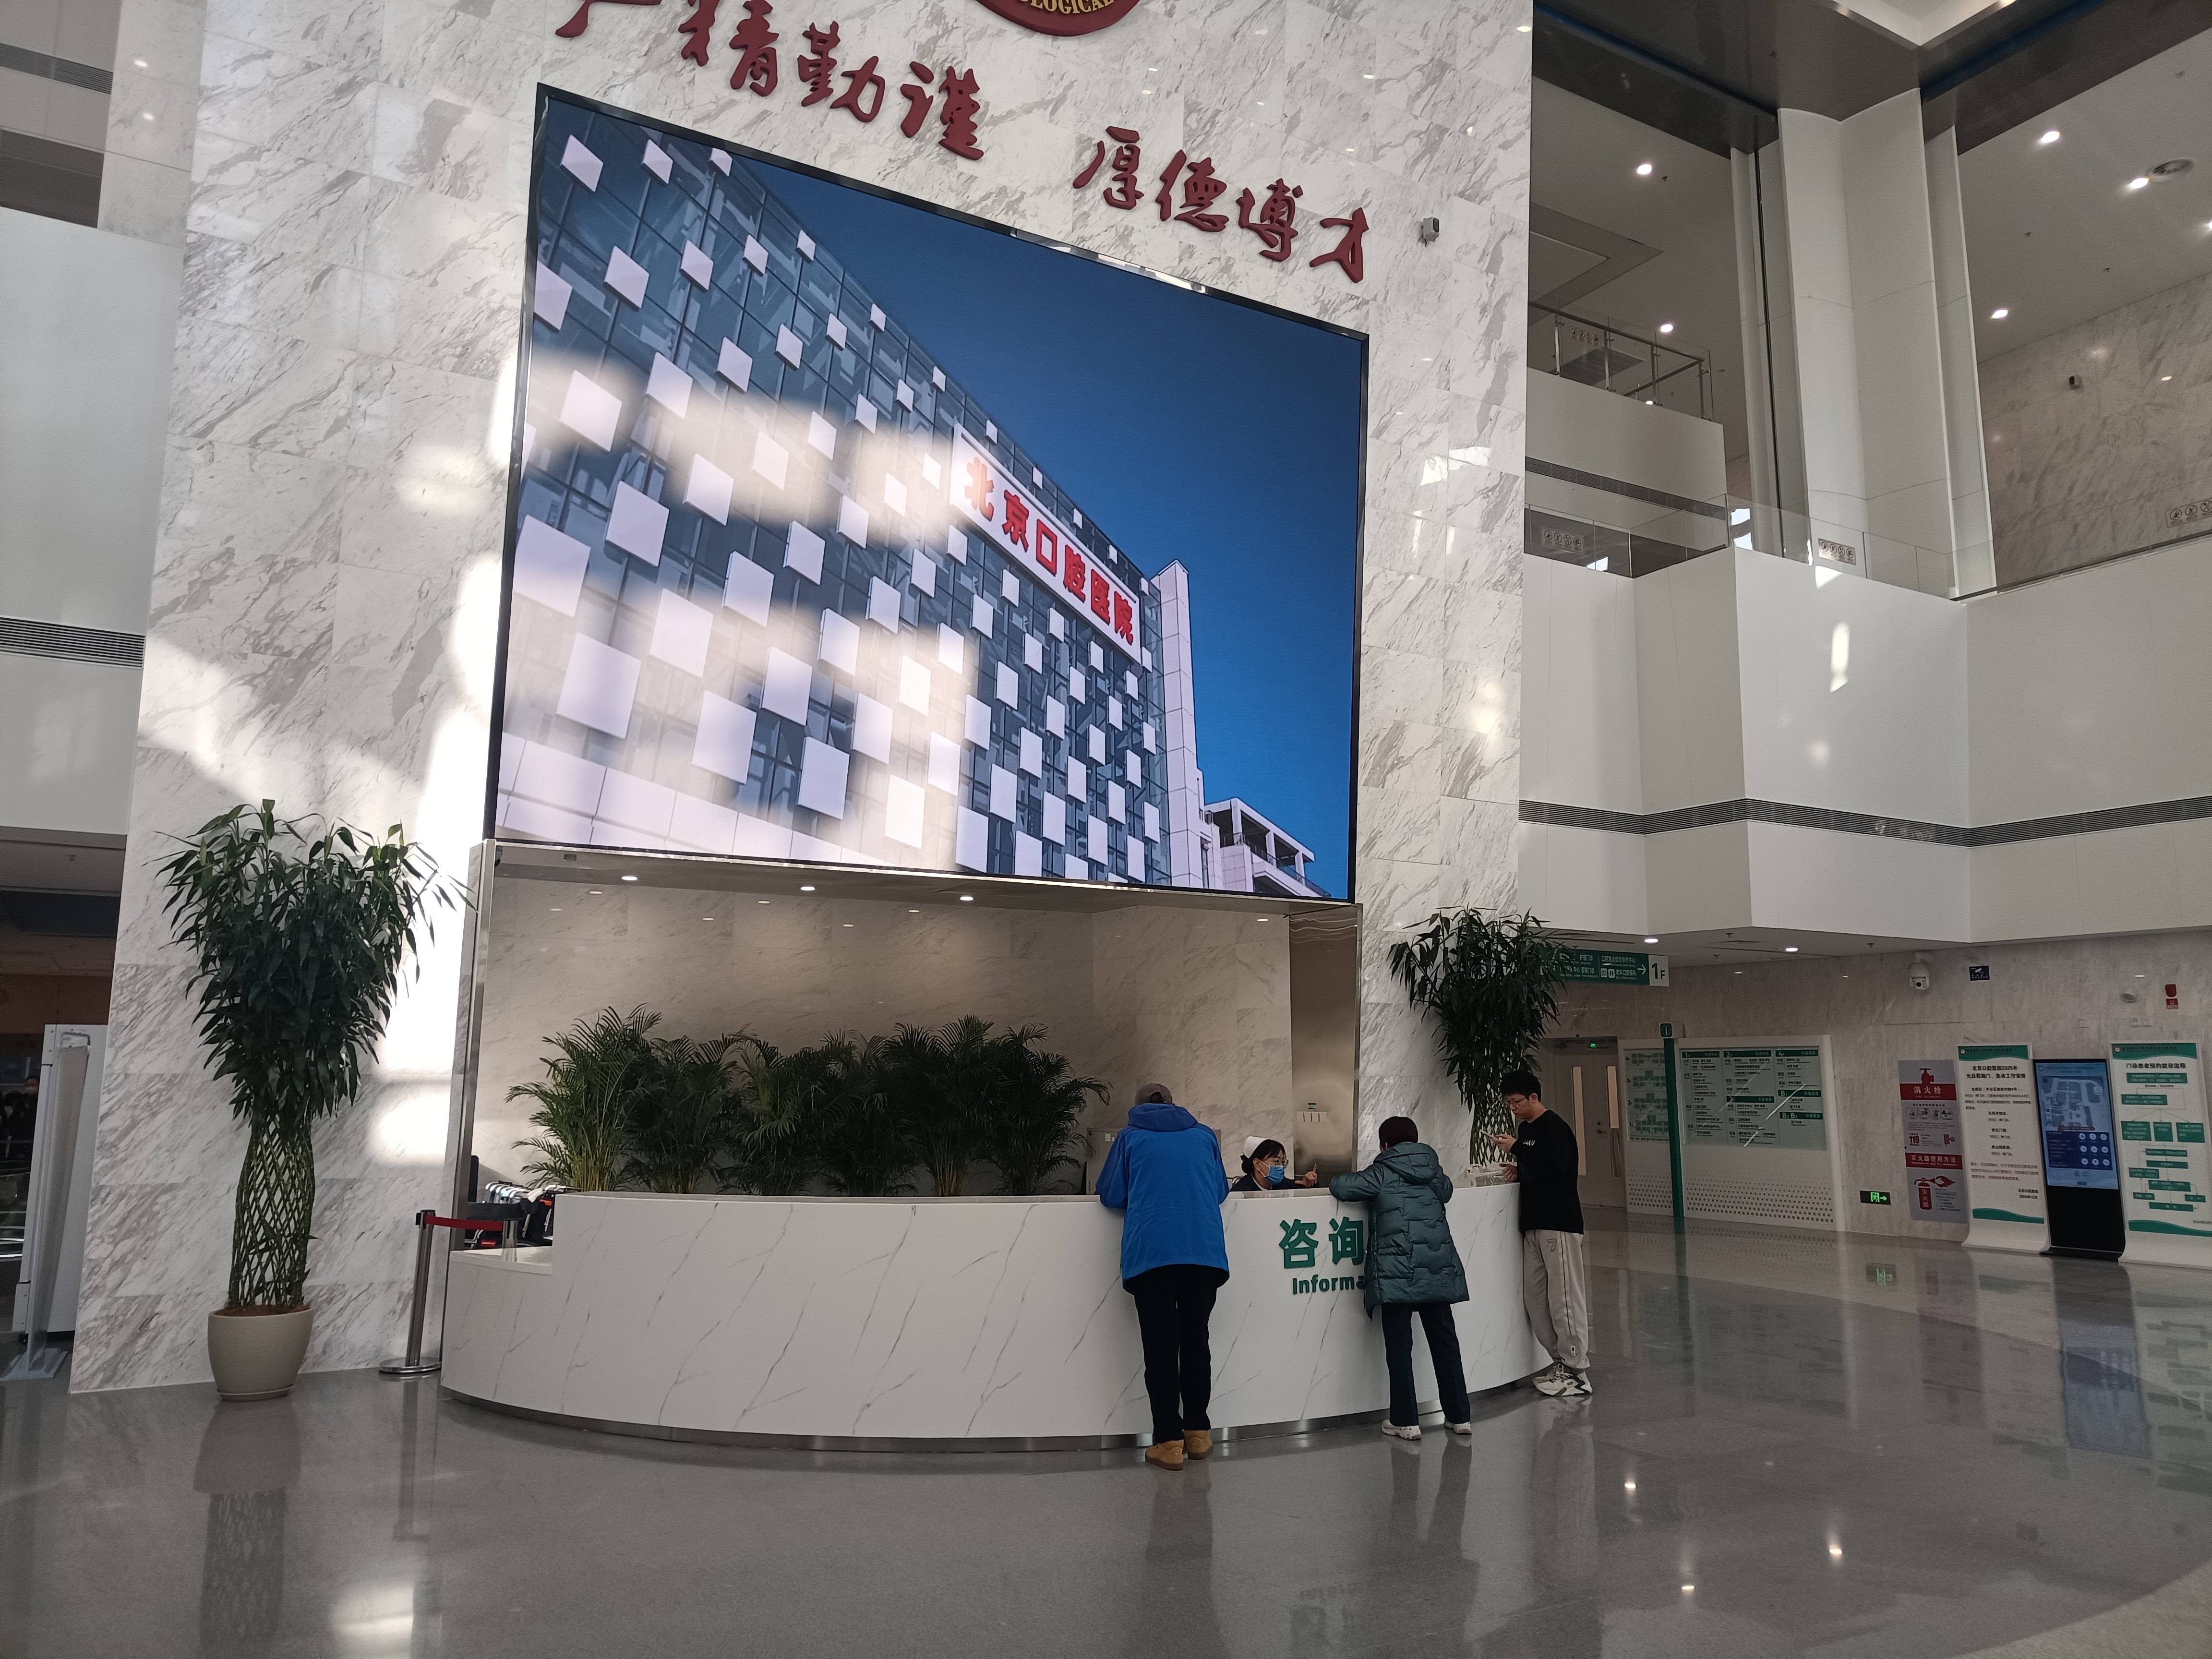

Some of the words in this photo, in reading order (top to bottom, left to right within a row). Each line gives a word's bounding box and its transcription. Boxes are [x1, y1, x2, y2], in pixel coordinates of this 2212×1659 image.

[964, 457, 1134, 646] 北京口腔医院
[1652, 963, 1665, 980] 1F
[1913, 1086, 1941, 1094] 消火栓
[1909, 1136, 1920, 1144] 119
[1911, 1154, 1956, 1163] 灭火器使用方法
[1279, 1216, 1364, 1269] 咨询
[1547, 1238, 1557, 1251] 7
